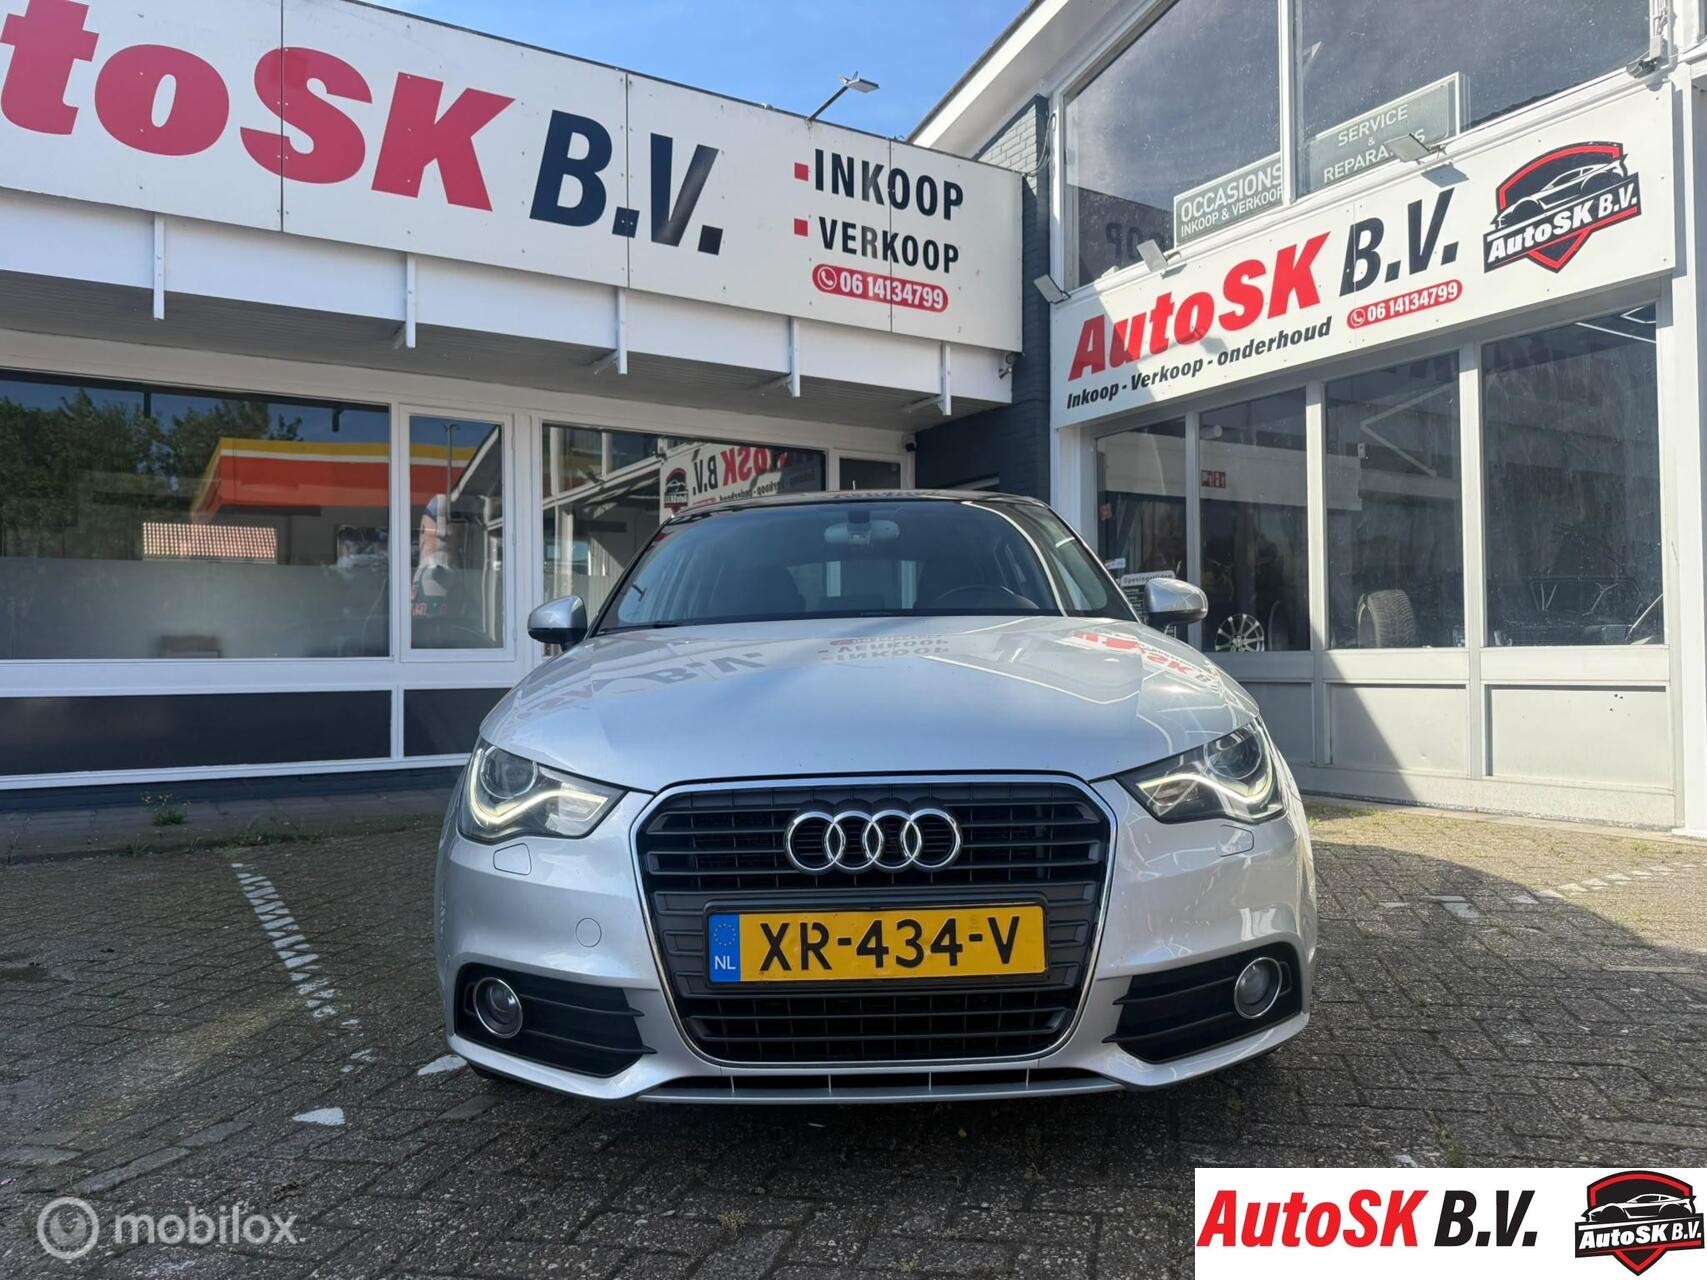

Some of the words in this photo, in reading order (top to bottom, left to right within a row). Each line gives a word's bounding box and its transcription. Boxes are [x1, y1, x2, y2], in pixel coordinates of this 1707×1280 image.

[1338, 104, 1408, 146] SERVICE
[1368, 136, 1376, 146] &
[529, 109, 724, 256] B.V.
[1323, 129, 1426, 183] REPARAS
[815, 148, 963, 221] INKOOP
[1181, 164, 1282, 222] OCCASIONS
[1181, 211, 1219, 238] INKOOP
[1221, 208, 1230, 221] &
[1232, 187, 1283, 216] VERKOOP
[818, 216, 960, 274] VERKOOP
[1487, 199, 1595, 264] AutoSK
[1598, 183, 1638, 219] B.V.
[840, 270, 863, 295] 06
[867, 275, 944, 309] 14134799
[1068, 231, 1332, 382] AutoSK
[1339, 187, 1459, 297] B.V.
[1367, 303, 1386, 322] 06
[1389, 281, 1458, 316] 14134799
[1066, 383, 1119, 409] Inkoop
[1131, 358, 1203, 392] Verkoop
[1217, 316, 1333, 366] onderhoud
[714, 956, 736, 971] NL
[759, 916, 1020, 972] XR-434-V
